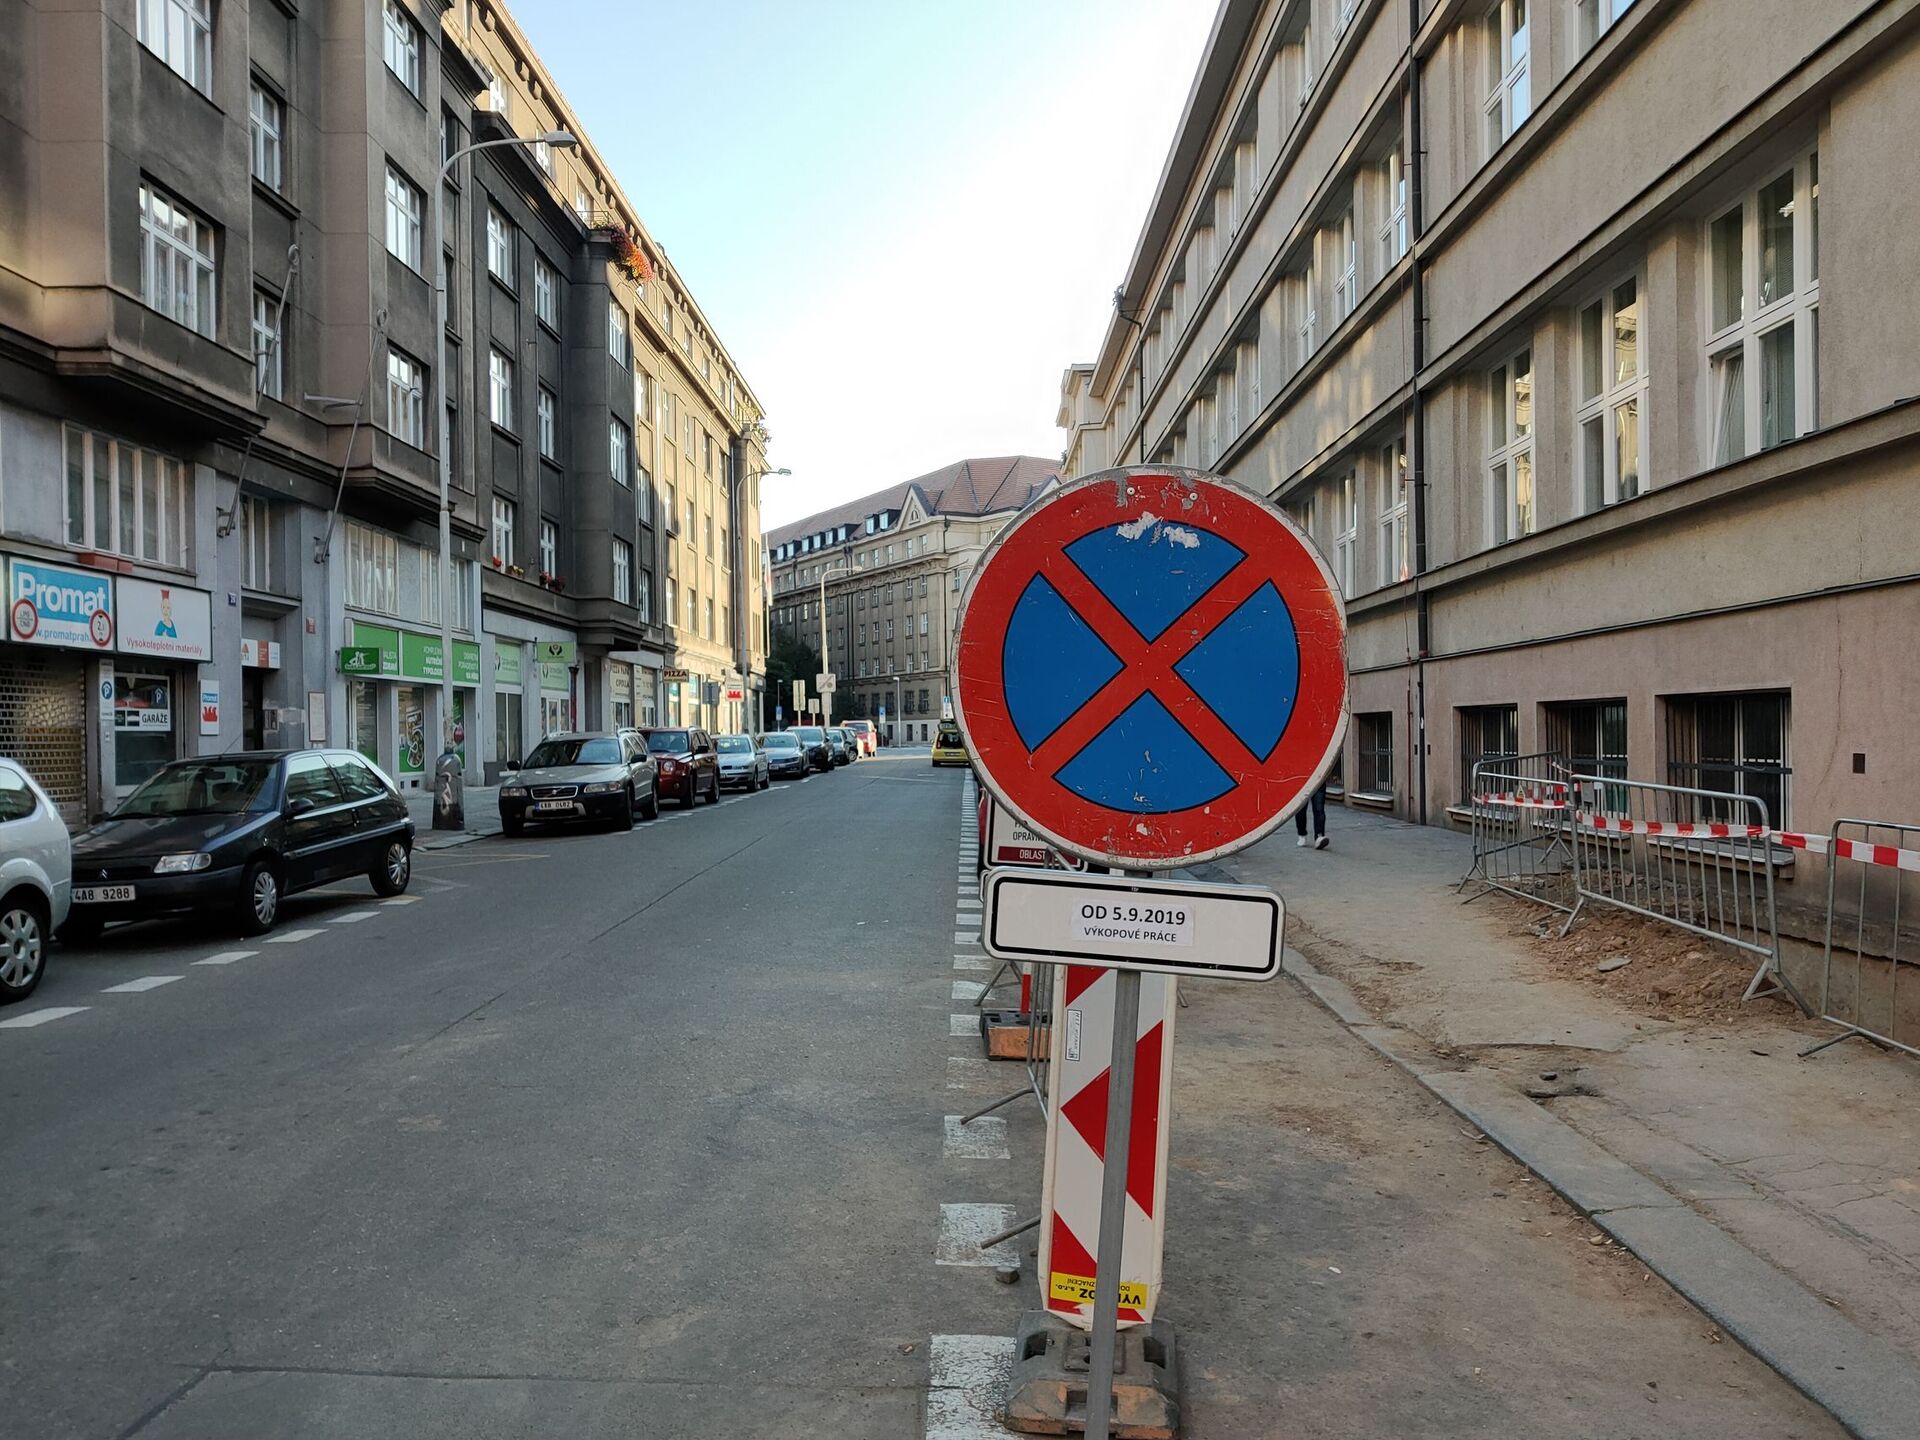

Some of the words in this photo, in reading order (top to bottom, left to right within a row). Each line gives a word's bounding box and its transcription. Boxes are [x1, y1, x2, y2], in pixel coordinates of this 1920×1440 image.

[17, 571, 105, 617] Promat
[142, 713, 168, 723] GARÁŽE
[74, 889, 94, 901] 4A8
[102, 888, 130, 900] 9288
[1081, 904, 1107, 920] OD
[1112, 906, 1186, 926] 5.9.2019
[1084, 926, 1140, 940] VÝKOPOVÉ
[1143, 929, 1177, 943] PRÁCE
